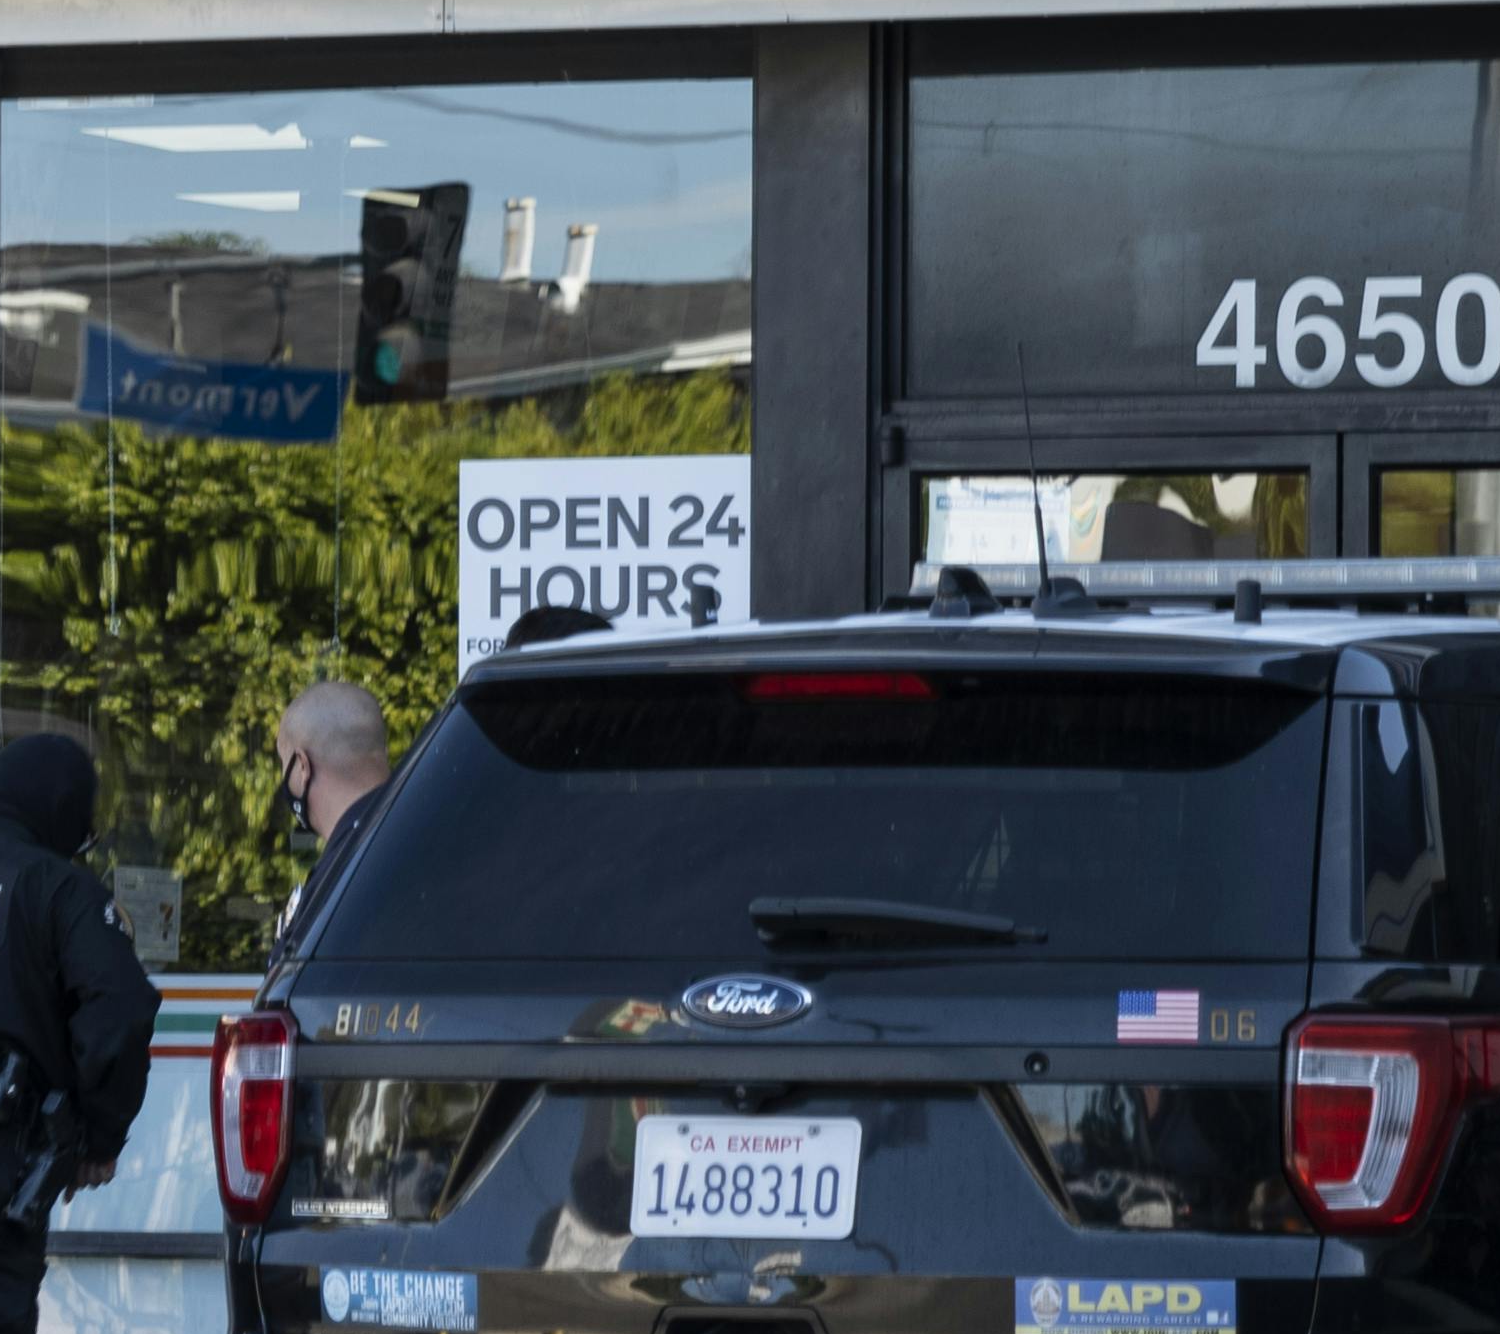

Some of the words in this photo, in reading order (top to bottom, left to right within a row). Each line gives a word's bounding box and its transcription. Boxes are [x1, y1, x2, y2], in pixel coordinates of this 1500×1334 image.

[467, 497, 650, 552] OPEN
[668, 494, 746, 549] 24
[489, 563, 722, 621] HOURS
[707, 980, 780, 1016] Ford
[335, 1002, 420, 1036] 81044
[1210, 1009, 1256, 1042] 06
[690, 1136, 716, 1153] CA
[727, 1135, 804, 1154] EXEMPT
[647, 1161, 840, 1220] 1488310
[326, 1202, 386, 1215] INTERCEPTOR
[350, 1272, 367, 1294] BE
[372, 1273, 400, 1296] THE
[404, 1274, 464, 1299] CHANGE
[1067, 1283, 1202, 1314] LAPD
[381, 1311, 428, 1328] COMMUNITY
[1081, 1314, 1150, 1325] REWARDING
[1154, 1315, 1201, 1325] CAREER
